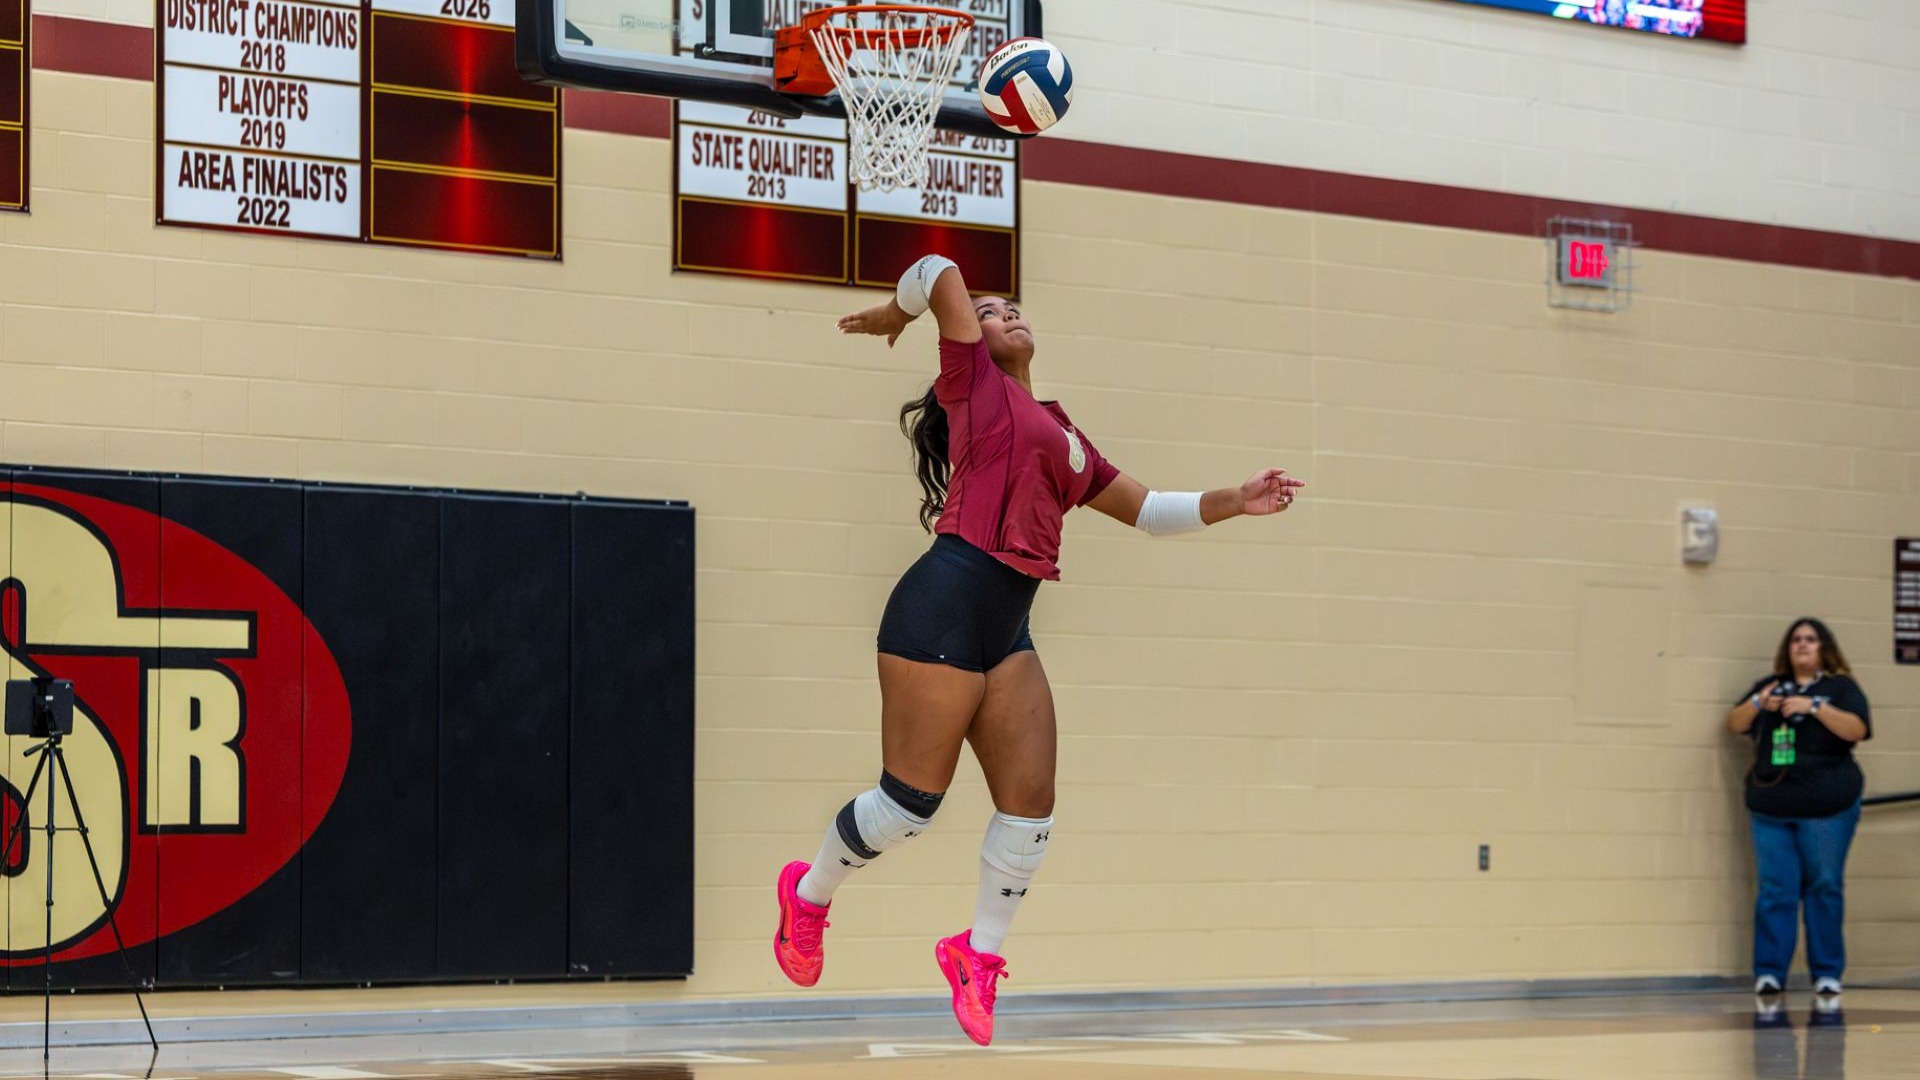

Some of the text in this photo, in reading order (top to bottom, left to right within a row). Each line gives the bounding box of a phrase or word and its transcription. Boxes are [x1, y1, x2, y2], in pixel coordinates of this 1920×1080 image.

[166, 0, 358, 50] DISTRICT CHAMPIONS
[240, 40, 286, 72] 2018
[218, 75, 309, 122] PLAYOFFS
[240, 118, 286, 150] 2019
[692, 131, 743, 171] STATE
[749, 137, 835, 181] QUALIFIER
[178, 150, 348, 203] AREA FINALISTS
[747, 175, 786, 200] 2013
[237, 197, 291, 229] 2022
[921, 192, 958, 217] 2013
